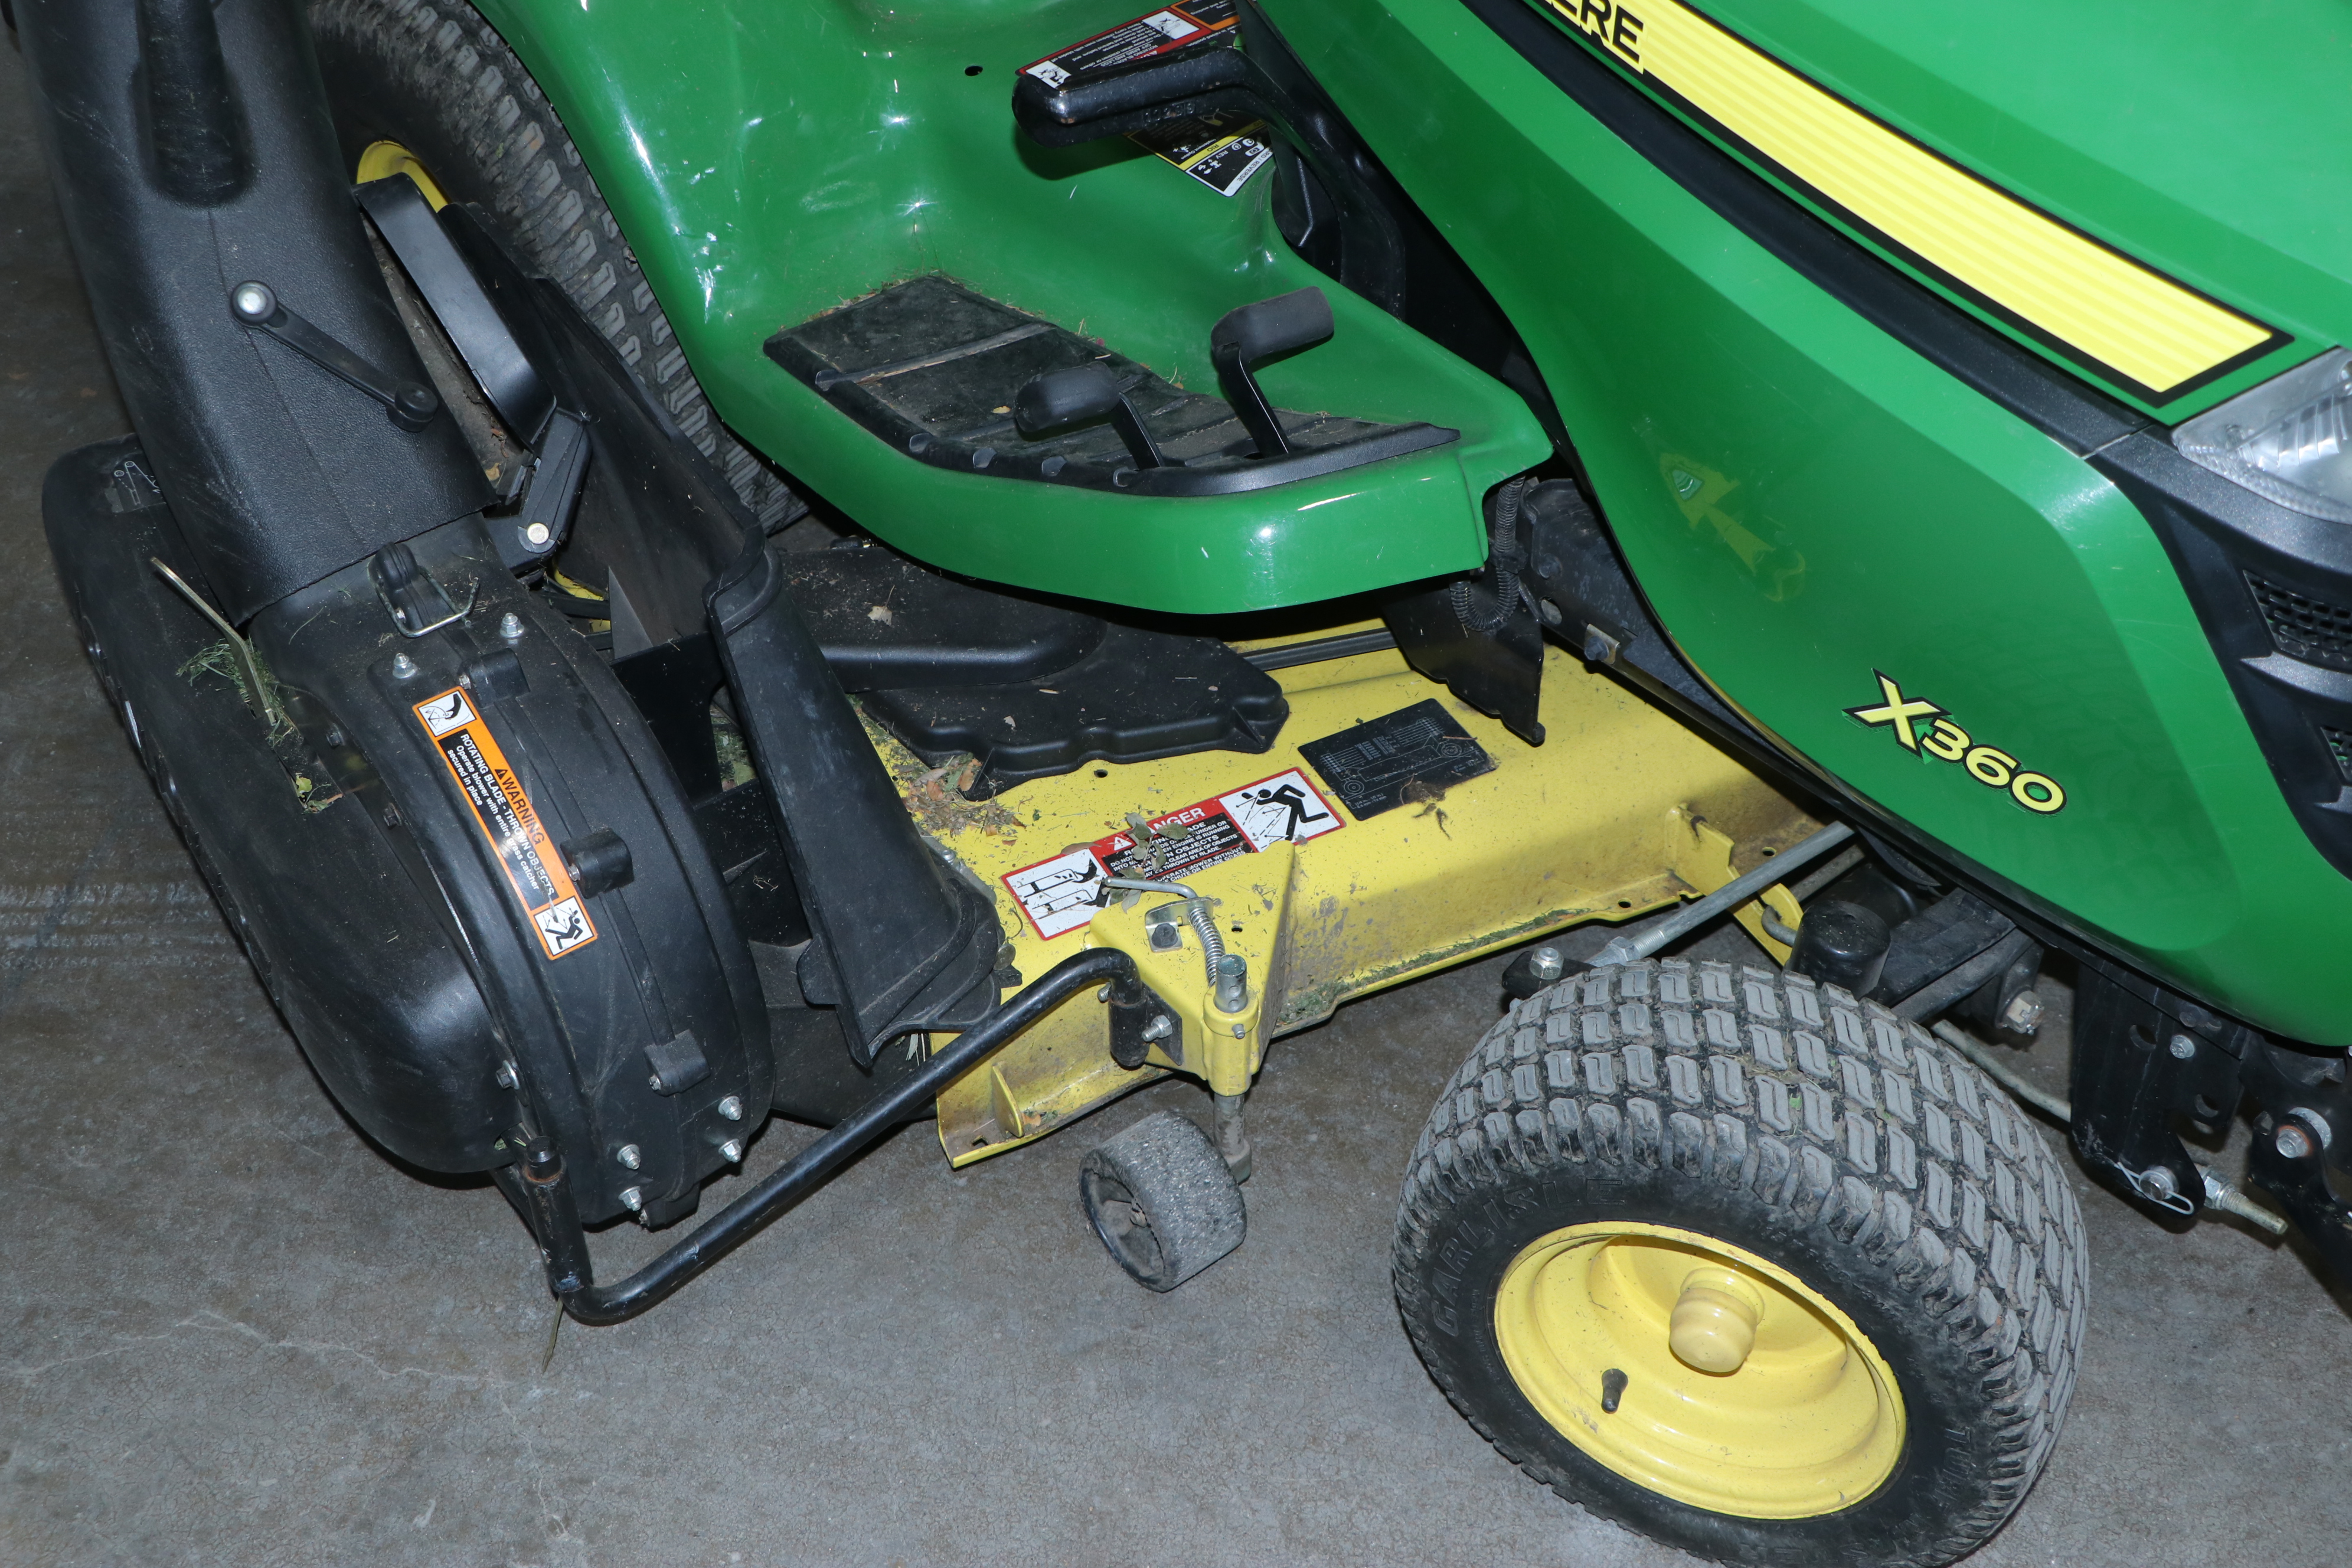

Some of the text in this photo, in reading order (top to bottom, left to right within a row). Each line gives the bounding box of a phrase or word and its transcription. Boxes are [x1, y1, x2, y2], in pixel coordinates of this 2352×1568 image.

[1099, 58, 1115, 67] LEGS
[1132, 43, 1158, 57] ROTATING
[1206, 142, 1219, 153] RIO
[1215, 148, 1229, 160] REV
[1237, 160, 1260, 182] REVERSE
[1843, 669, 2066, 814] X360
[446, 748, 484, 806] secured in place
[454, 744, 541, 891] Operate blower with entire grass catcher
[460, 733, 489, 774] ROTATING
[483, 773, 507, 805] BLADE
[502, 808, 532, 851] THROWN
[525, 850, 556, 896] OBJECTS
[500, 776, 546, 845] WARNING
[1112, 862, 1129, 871] INTO
[1171, 837, 1195, 849] ENGINE
[1201, 824, 1231, 838] RUNNING
[1120, 855, 1134, 863] NOT
[1195, 824, 1217, 835] UNDER
[1167, 852, 1188, 863] CLEAR
[1187, 845, 1204, 856] AREA
[1210, 833, 1238, 847] OBJECTS
[1174, 834, 1220, 855] OBJECTS
[1187, 857, 1213, 870] MOWER
[1213, 846, 1243, 861] WITHOUT
[1162, 856, 1190, 871] THROWN
[1169, 870, 1191, 881] CHUTE
[1200, 857, 1224, 870] ENTIRE
[1223, 850, 1246, 861] GRASS
[1431, 1178, 1626, 1337] CARLISLE
